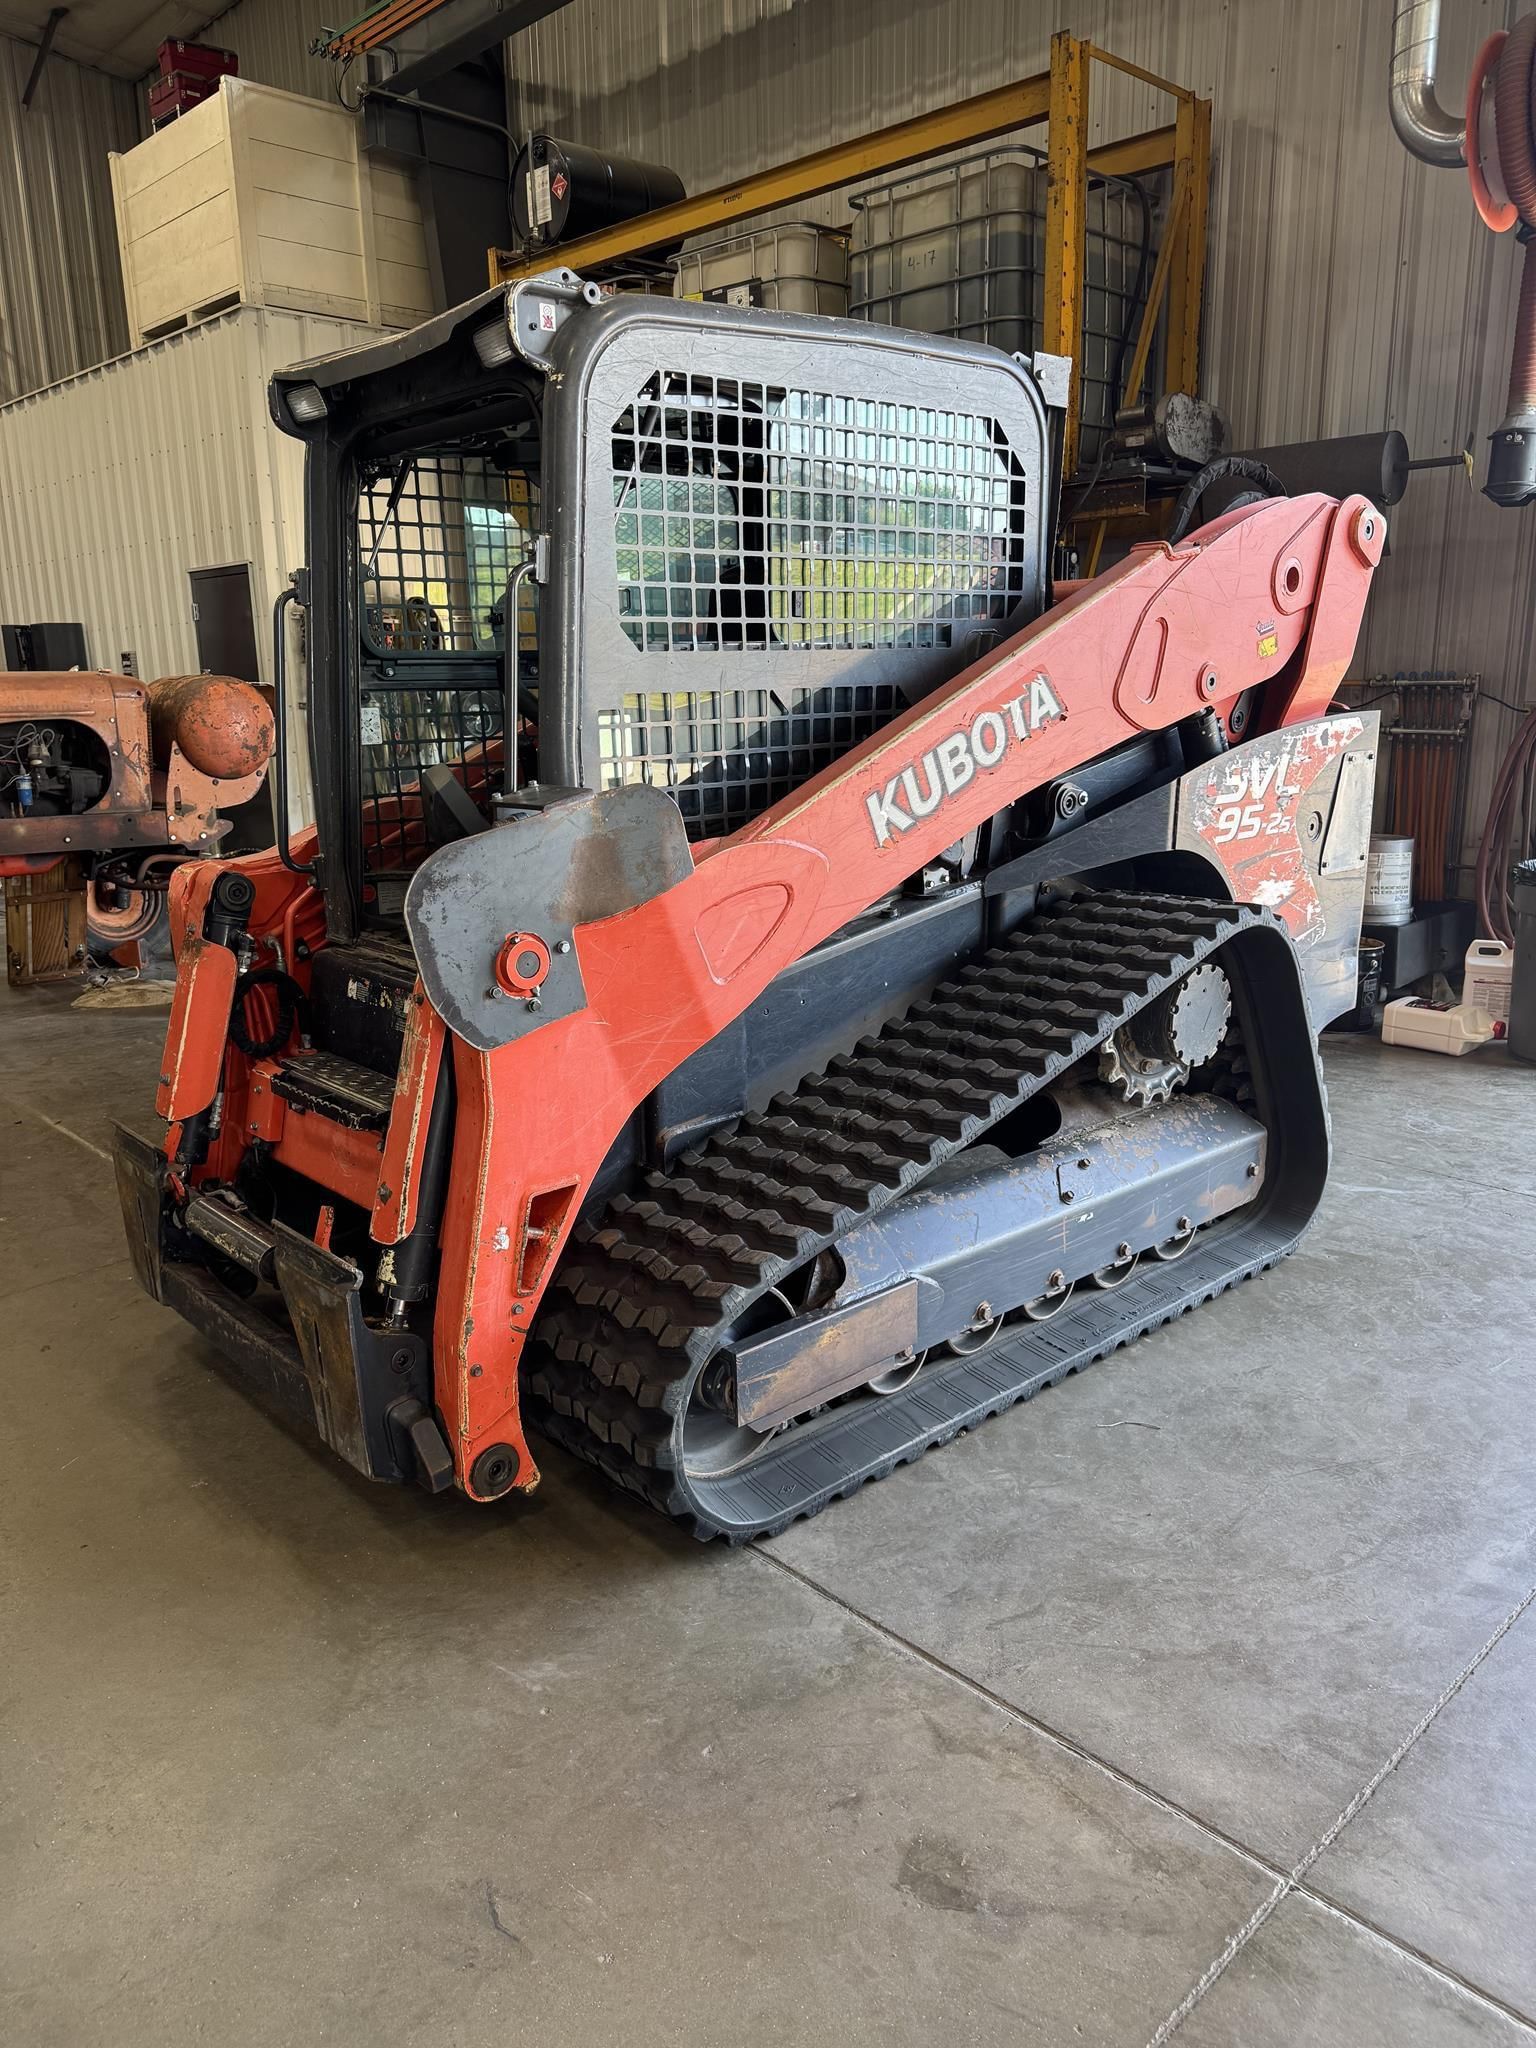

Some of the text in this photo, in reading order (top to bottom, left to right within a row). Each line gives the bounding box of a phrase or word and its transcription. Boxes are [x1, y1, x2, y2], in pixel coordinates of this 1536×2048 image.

[907, 249, 936, 271] 4-17
[866, 673, 1061, 848] KUBOTA
[1215, 751, 1302, 804] SVL
